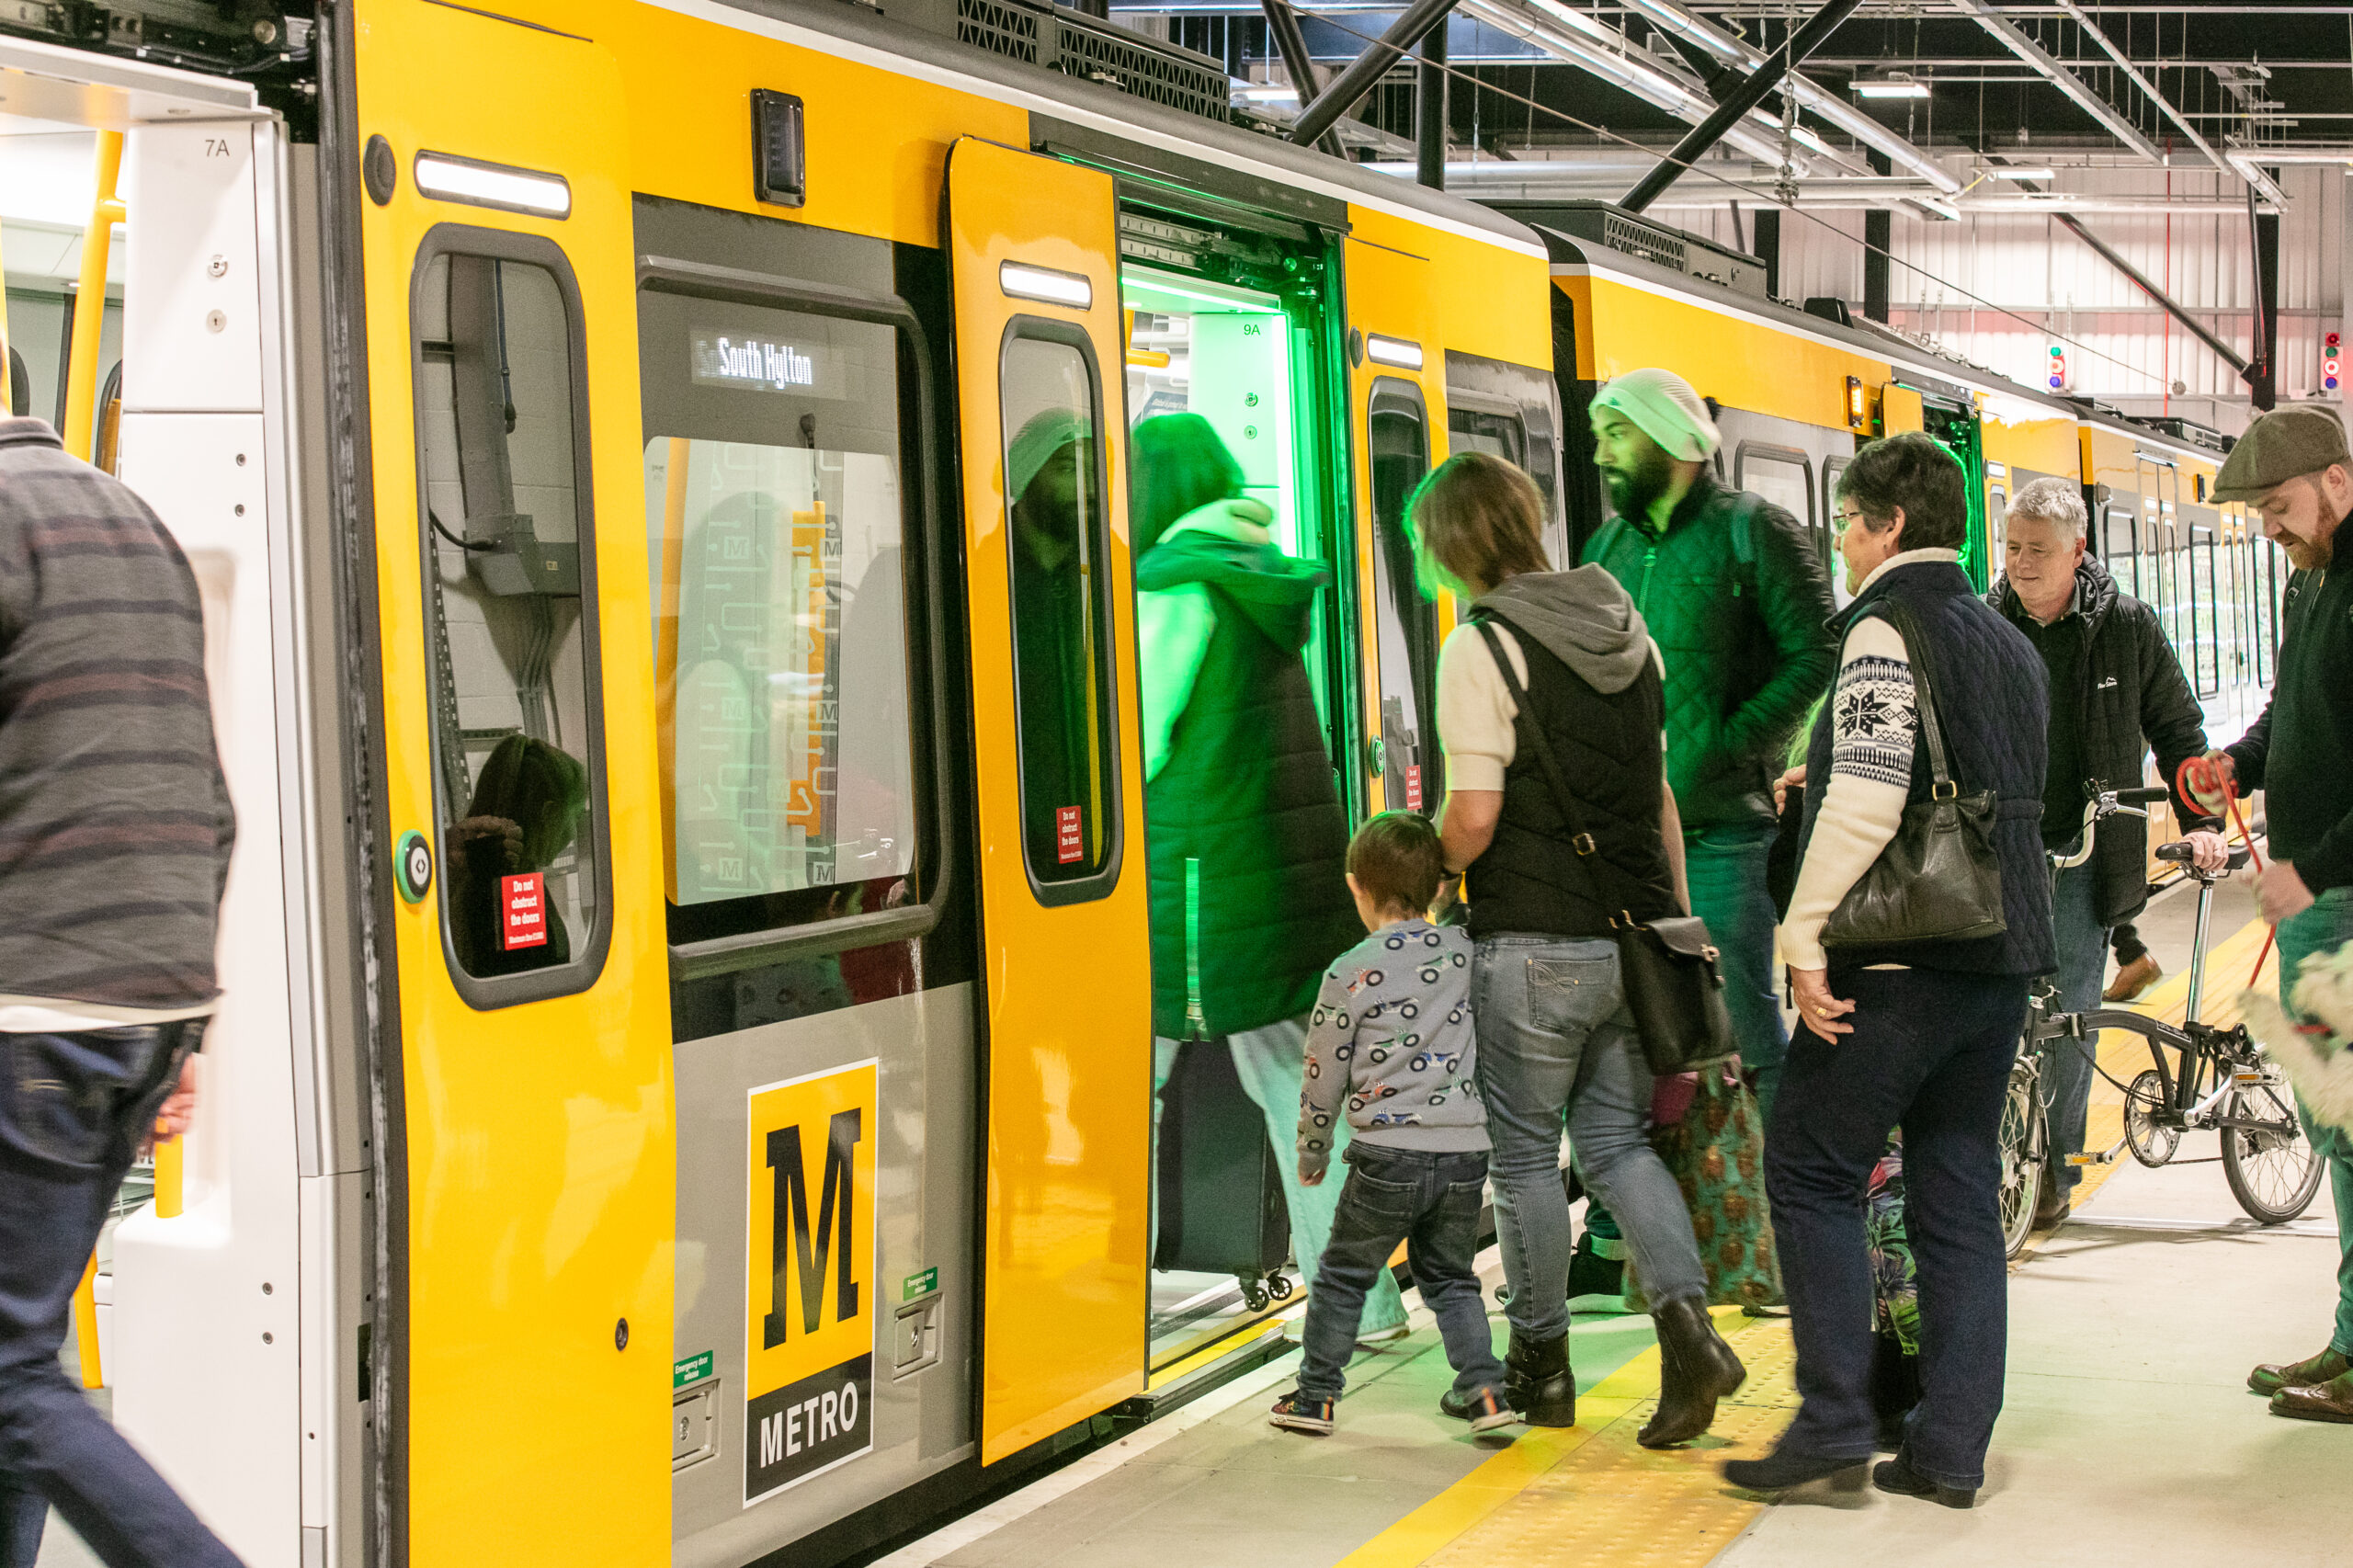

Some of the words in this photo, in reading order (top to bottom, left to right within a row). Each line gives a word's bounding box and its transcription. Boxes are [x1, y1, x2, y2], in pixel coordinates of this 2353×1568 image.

[205, 139, 230, 156] 7A
[1244, 324, 1260, 335] 9A
[717, 336, 763, 380] South
[764, 343, 813, 390] Hylton
[1063, 812, 1069, 820] Do
[816, 864, 835, 882] M
[513, 880, 523, 892] Do
[523, 879, 534, 891] not
[512, 895, 537, 909] obstruct
[511, 914, 522, 926] the
[522, 912, 540, 924] doors
[763, 1107, 862, 1351] M
[675, 1360, 698, 1375] Emergency
[698, 1356, 708, 1366] door
[684, 1370, 699, 1381] release
[760, 1381, 858, 1468] METRO
